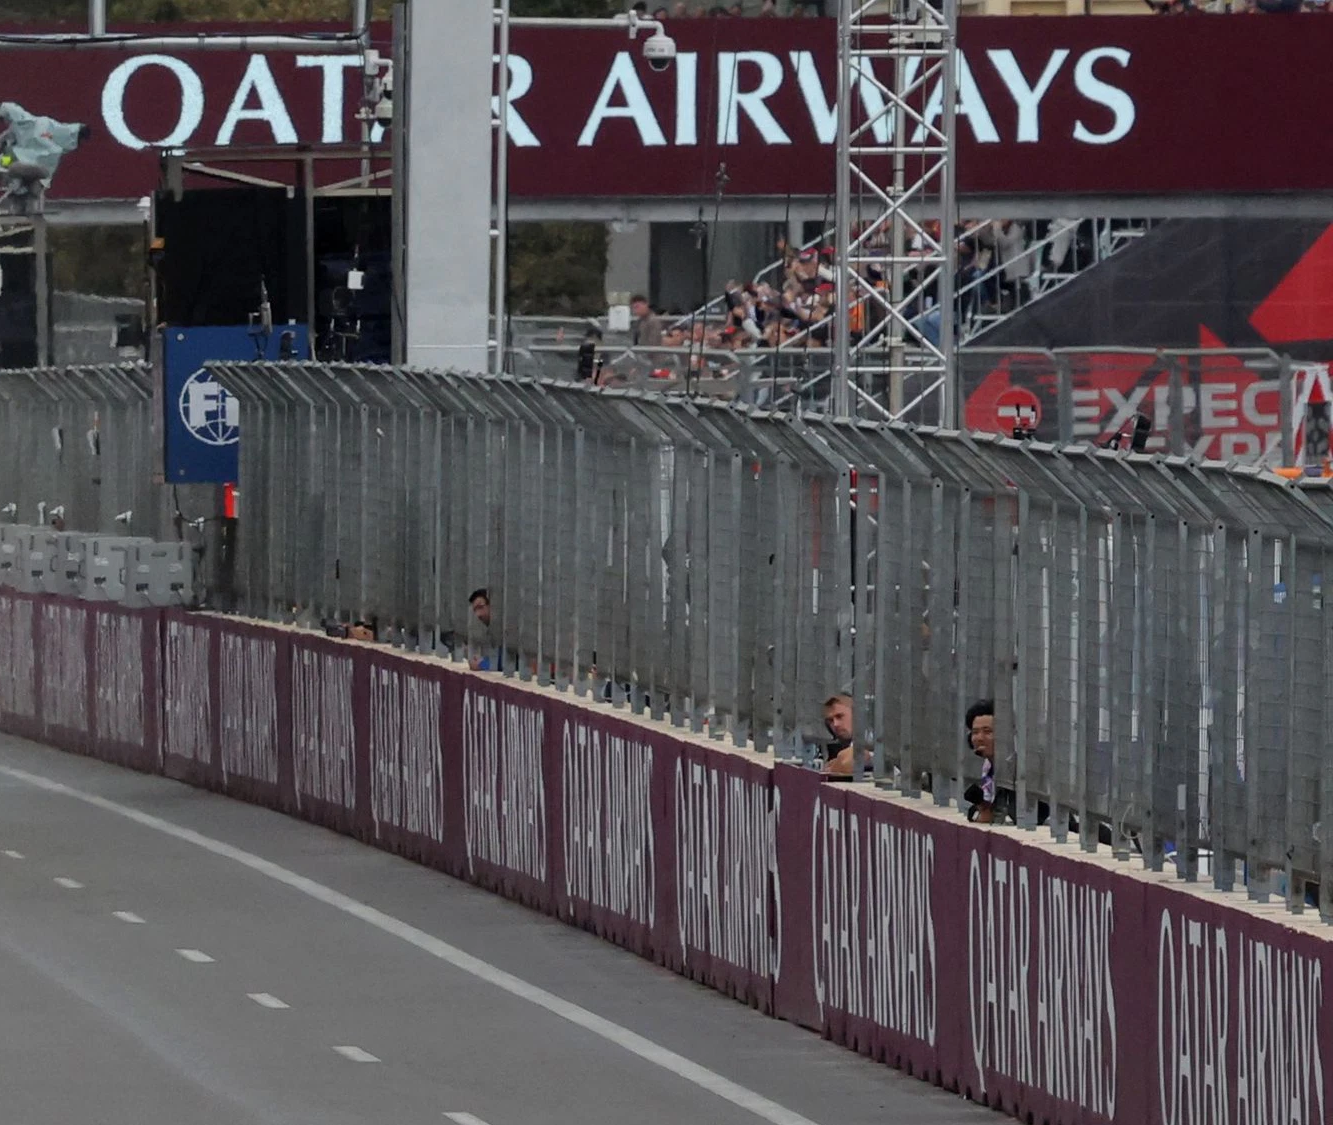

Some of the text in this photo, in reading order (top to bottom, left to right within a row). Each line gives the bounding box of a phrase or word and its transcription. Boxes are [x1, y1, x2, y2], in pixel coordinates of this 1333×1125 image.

[100, 46, 1135, 156] QATR AIRWAYS
[562, 719, 656, 931] QATAR AIRWAYS
[675, 757, 782, 984] QATAR AIRWAYS
[811, 796, 936, 1048] QATAR AIRWAYS
[968, 849, 1117, 1121] QATAR AIRWAYS
